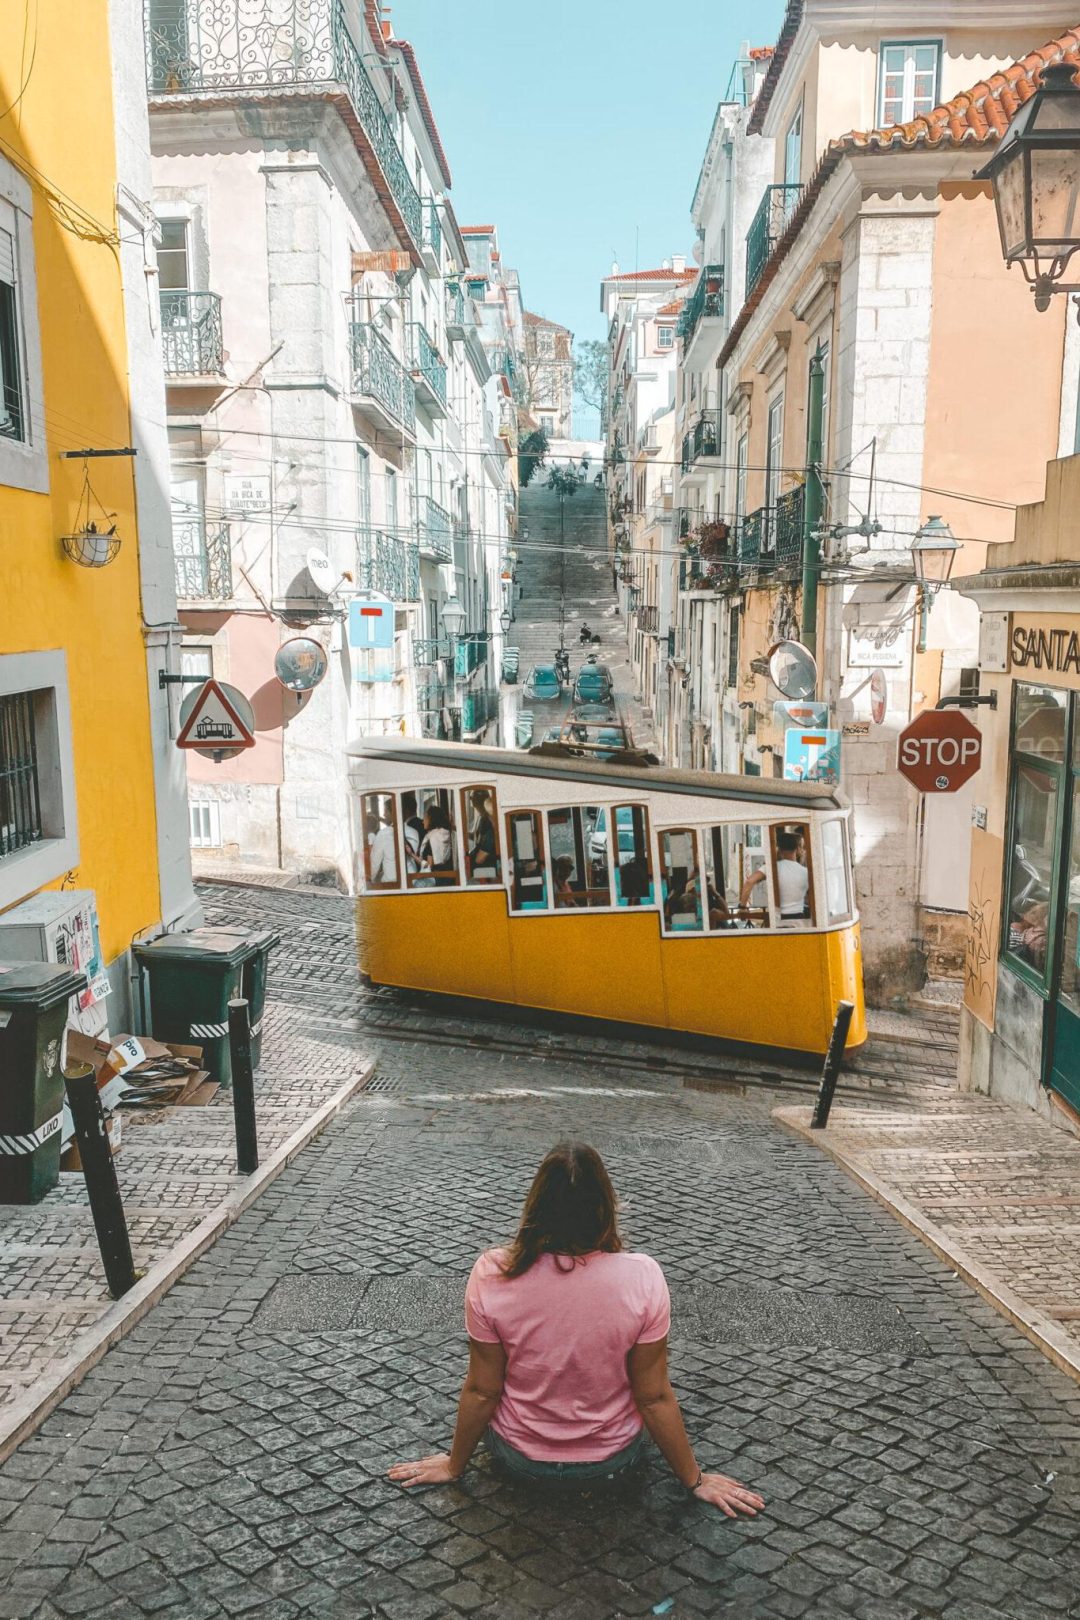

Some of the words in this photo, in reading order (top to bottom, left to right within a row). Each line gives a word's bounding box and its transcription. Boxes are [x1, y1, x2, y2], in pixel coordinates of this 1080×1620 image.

[311, 559, 328, 569] meo
[1011, 627, 1080, 674] SANTA
[901, 737, 980, 766] STOP
[122, 1041, 138, 1057] pro
[42, 1118, 59, 1138] LIXO
